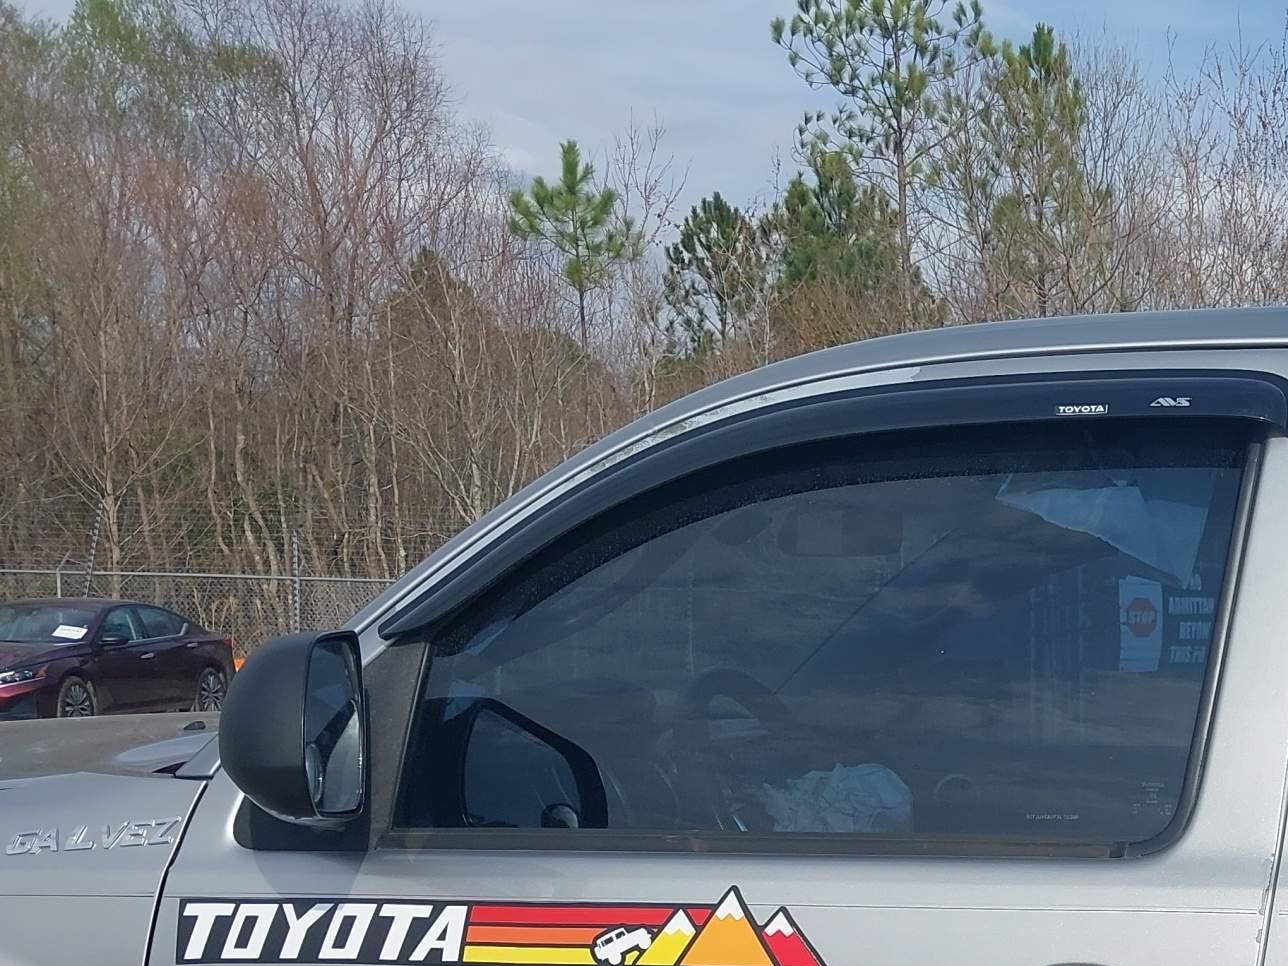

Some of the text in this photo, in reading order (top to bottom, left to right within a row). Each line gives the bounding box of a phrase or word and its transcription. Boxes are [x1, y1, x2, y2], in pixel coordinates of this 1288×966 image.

[1058, 404, 1105, 414] TOYOTA
[1128, 610, 1154, 625] STOP
[6, 816, 182, 855] GALVEZ
[182, 902, 469, 962] TOYOTA
